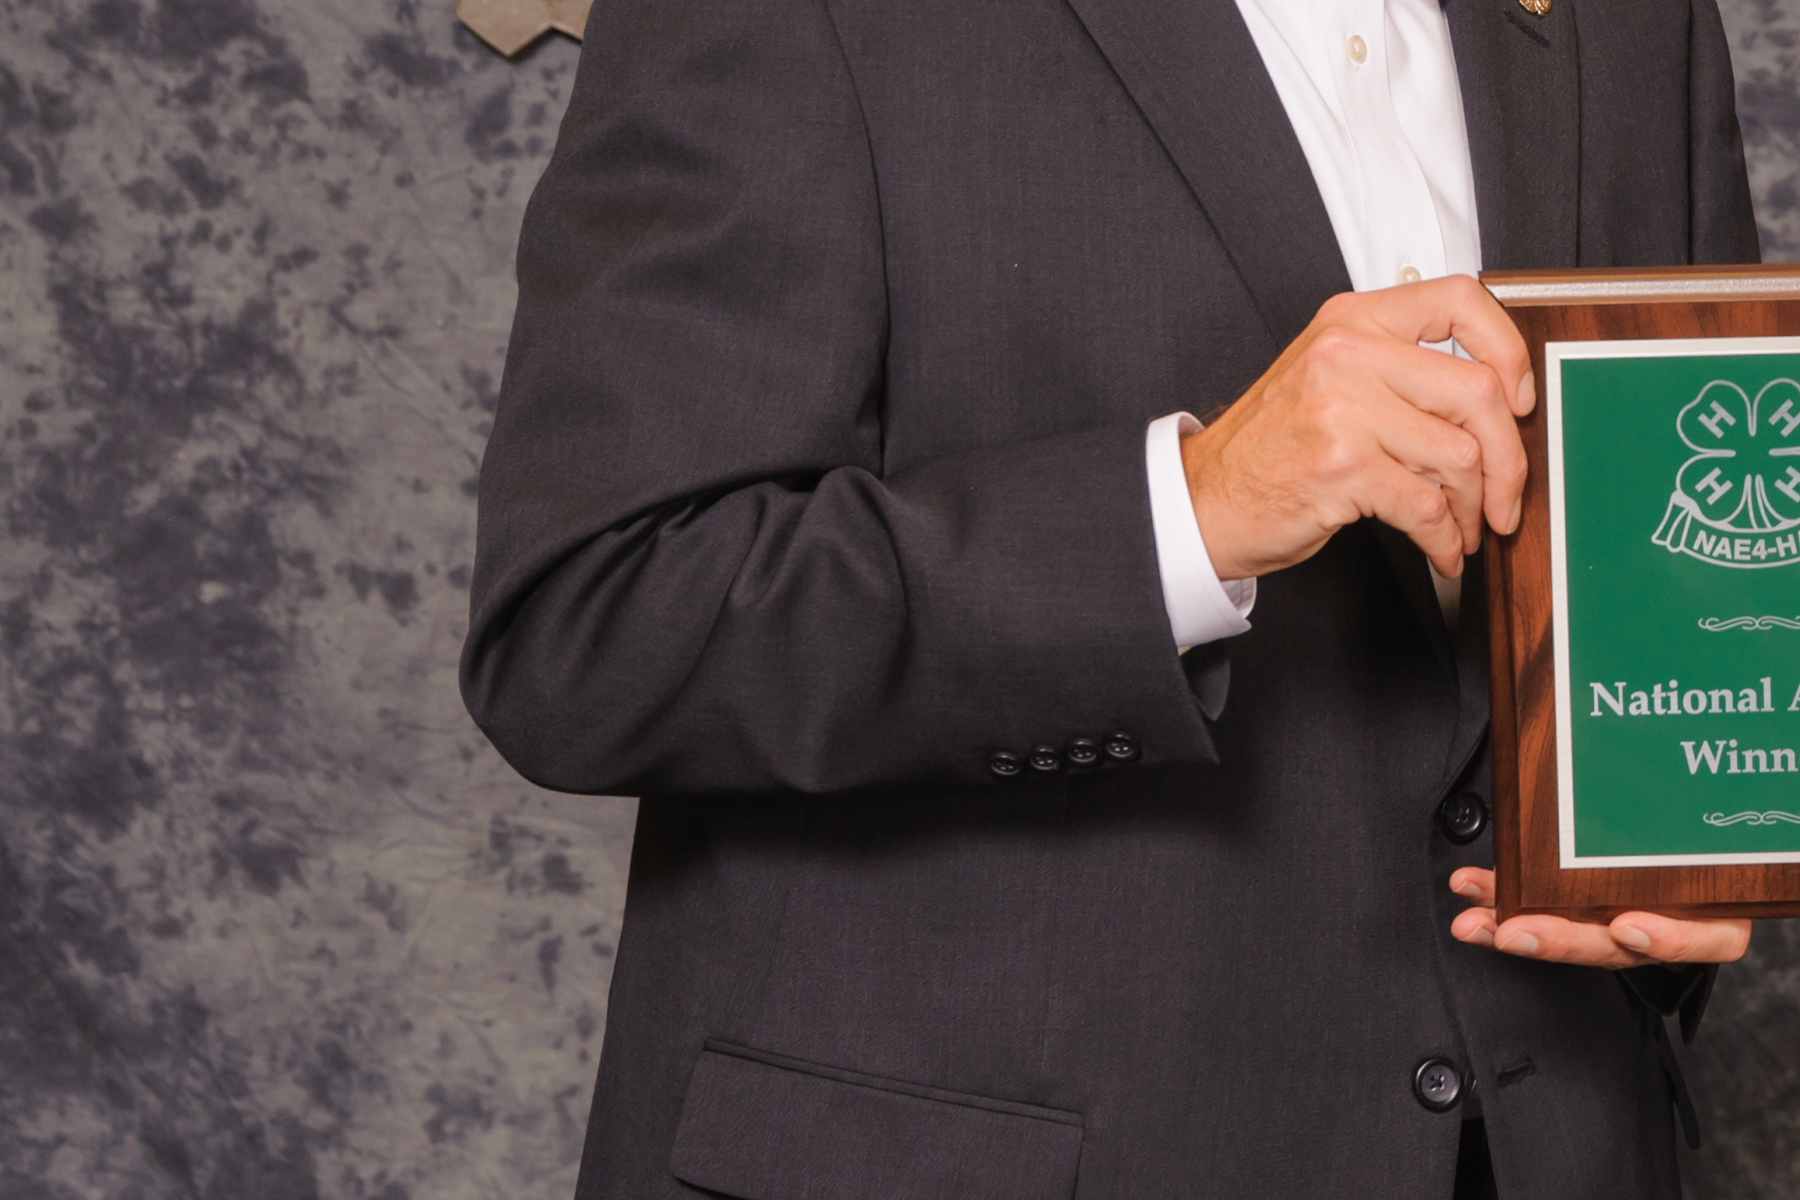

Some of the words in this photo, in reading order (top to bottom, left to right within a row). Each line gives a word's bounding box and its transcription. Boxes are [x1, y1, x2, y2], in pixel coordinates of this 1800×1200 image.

[1698, 400, 1736, 439] H
[1695, 466, 1733, 505] H
[1589, 676, 1775, 717] National
